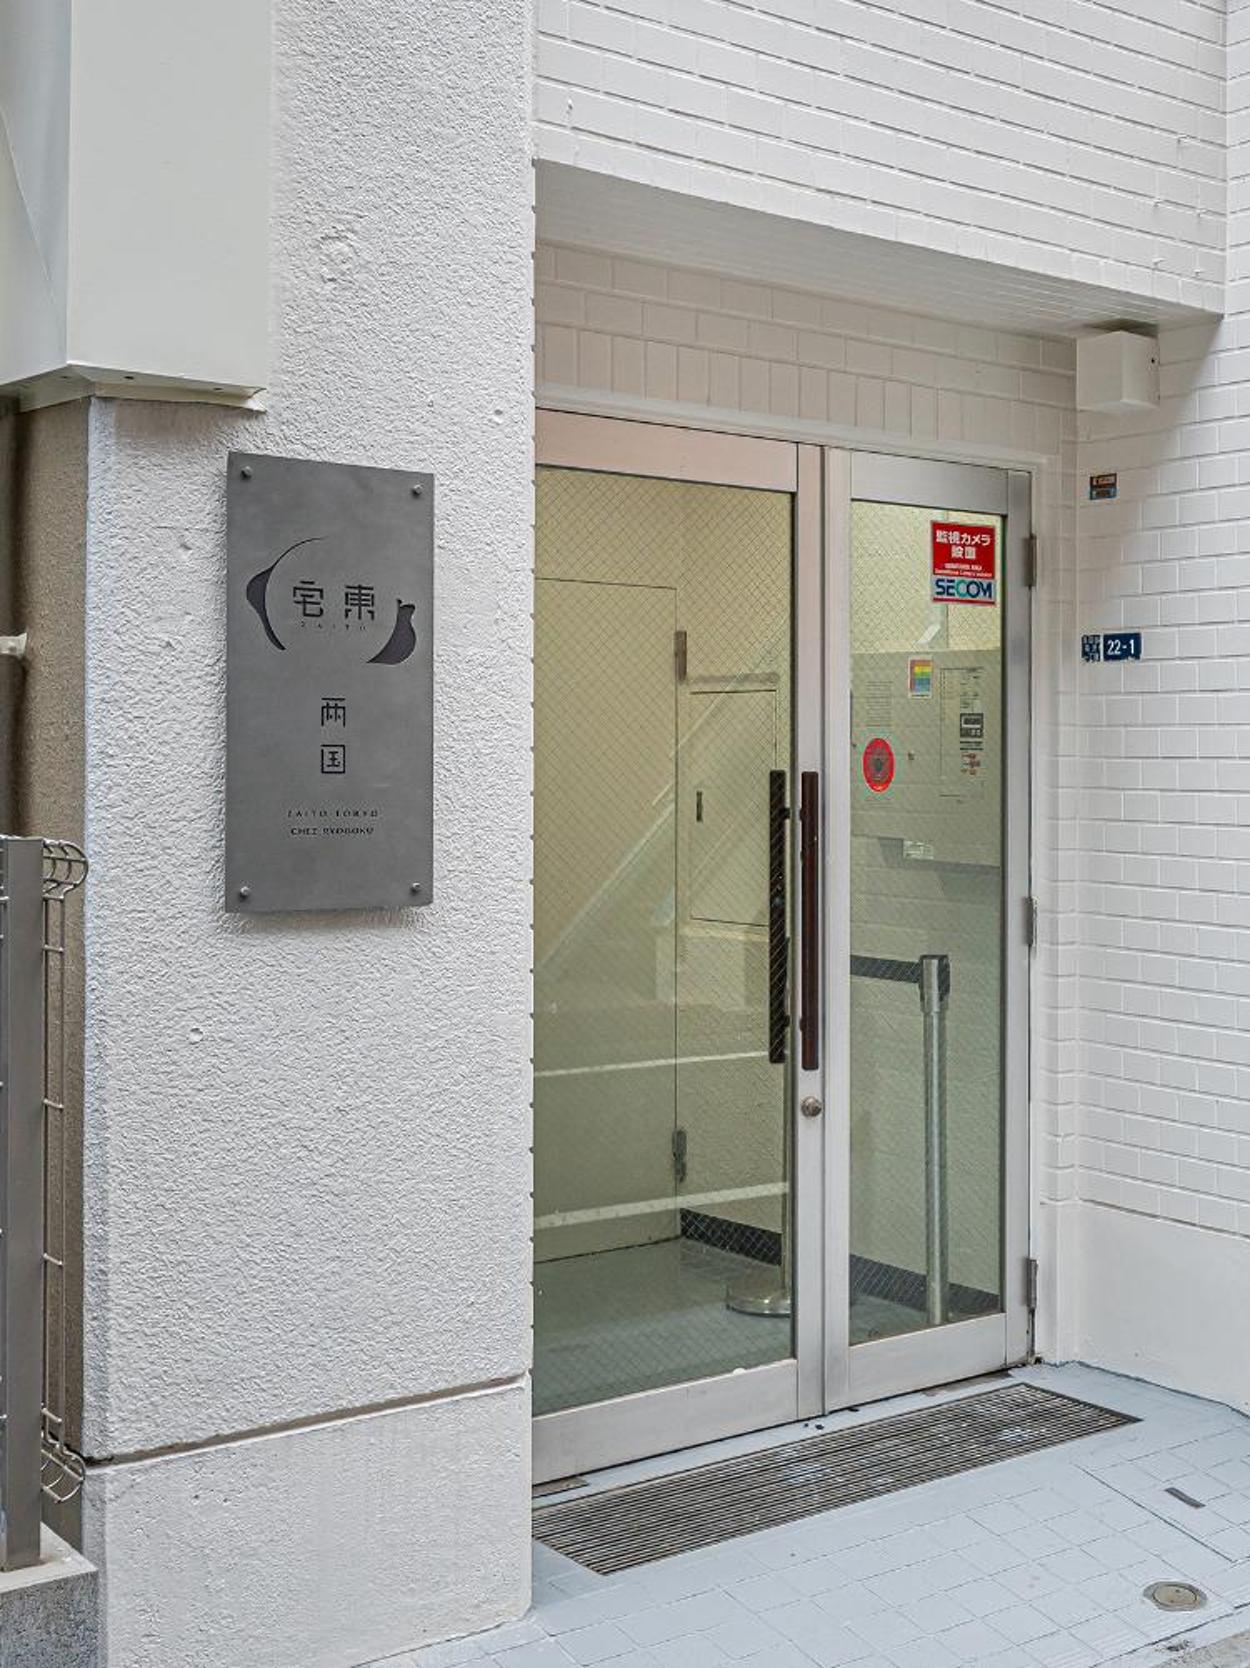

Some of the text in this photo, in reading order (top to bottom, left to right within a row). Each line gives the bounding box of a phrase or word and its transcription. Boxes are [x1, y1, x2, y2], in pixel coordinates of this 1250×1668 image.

[936, 530, 991, 546] 監視カメラ
[935, 578, 992, 598] SECOM
[1107, 639, 1135, 655] 22-1
